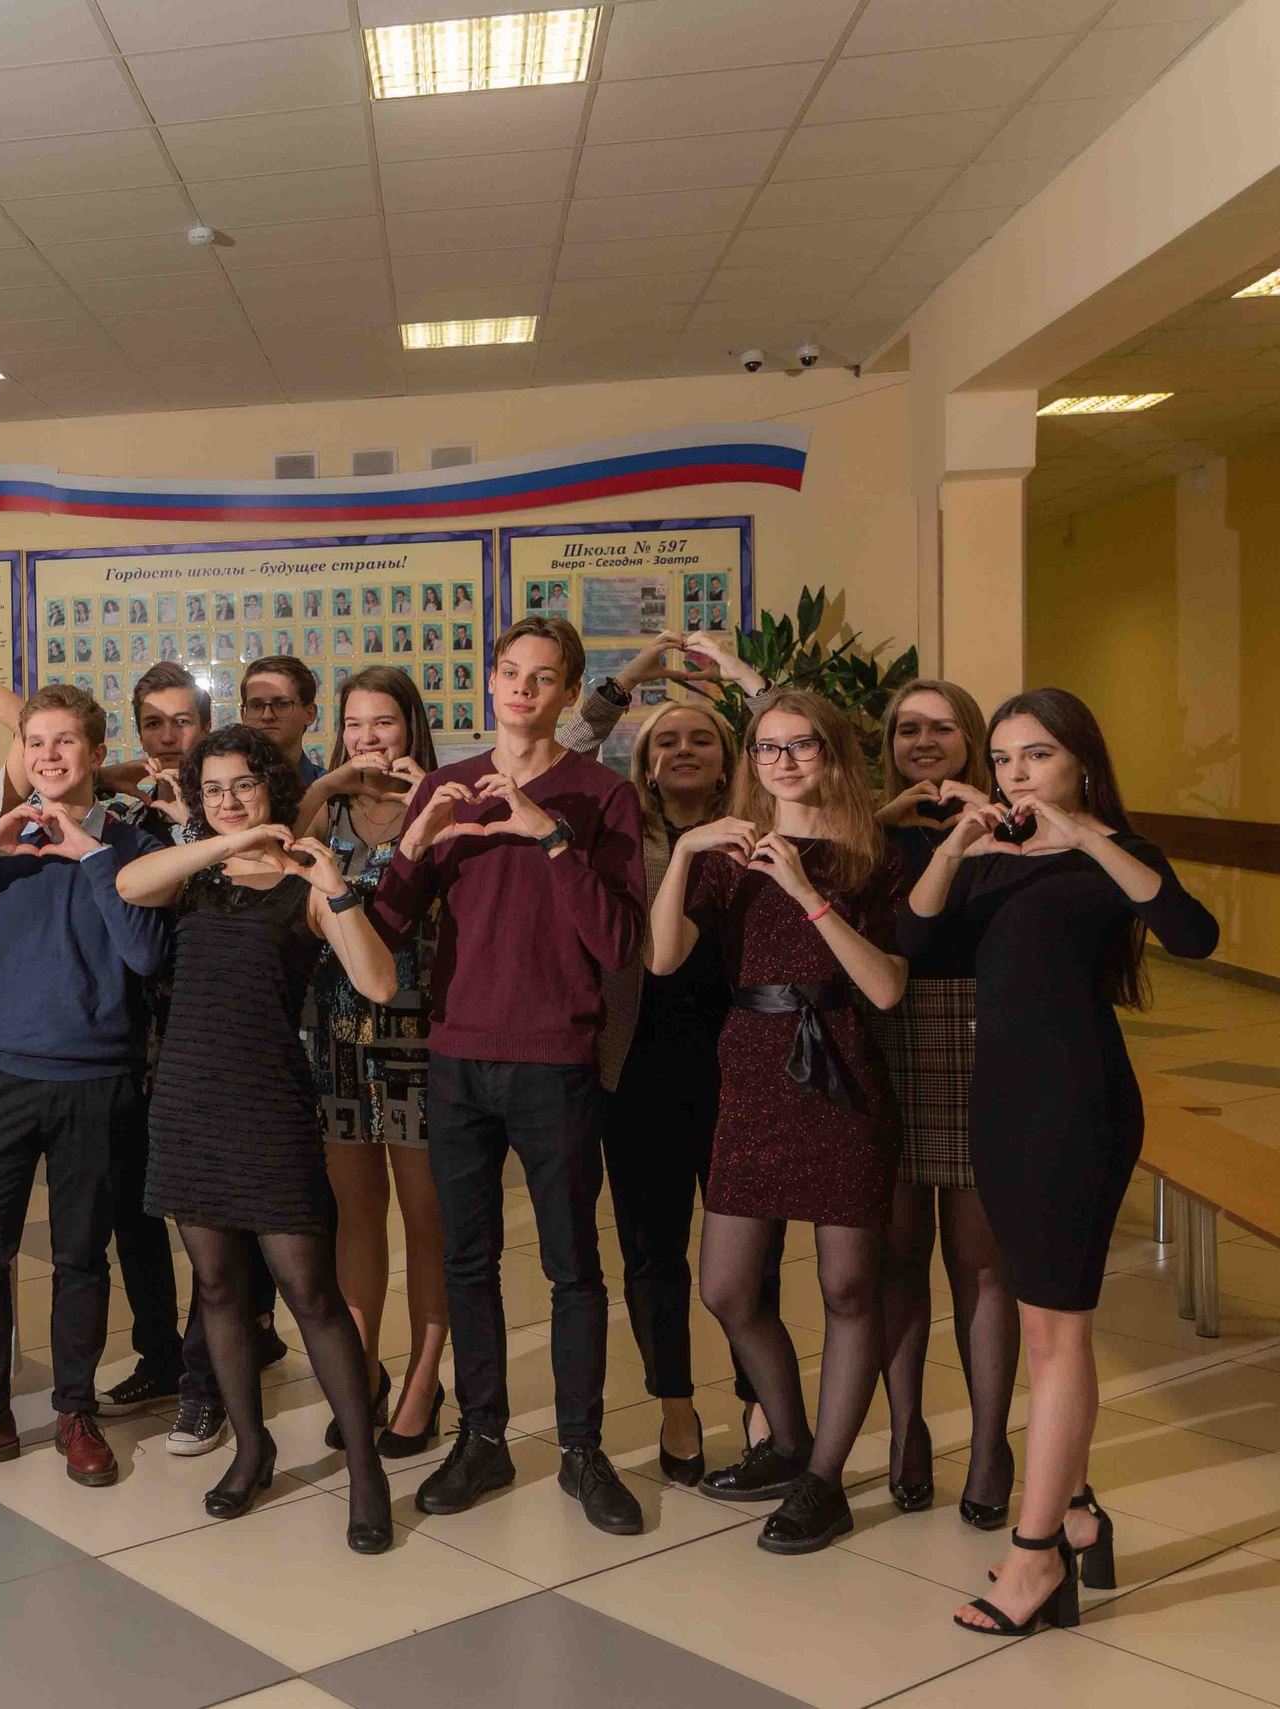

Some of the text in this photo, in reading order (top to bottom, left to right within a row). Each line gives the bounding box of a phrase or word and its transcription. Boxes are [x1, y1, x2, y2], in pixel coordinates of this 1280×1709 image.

[562, 539, 688, 557] Школа № 597
[105, 567, 183, 583] Гордость
[187, 564, 246, 578] школы
[260, 561, 327, 577] будущее
[331, 555, 408, 573] страны!
[551, 559, 586, 571] Вчера
[595, 557, 643, 568] Сегодня
[653, 555, 699, 565] Завтра
